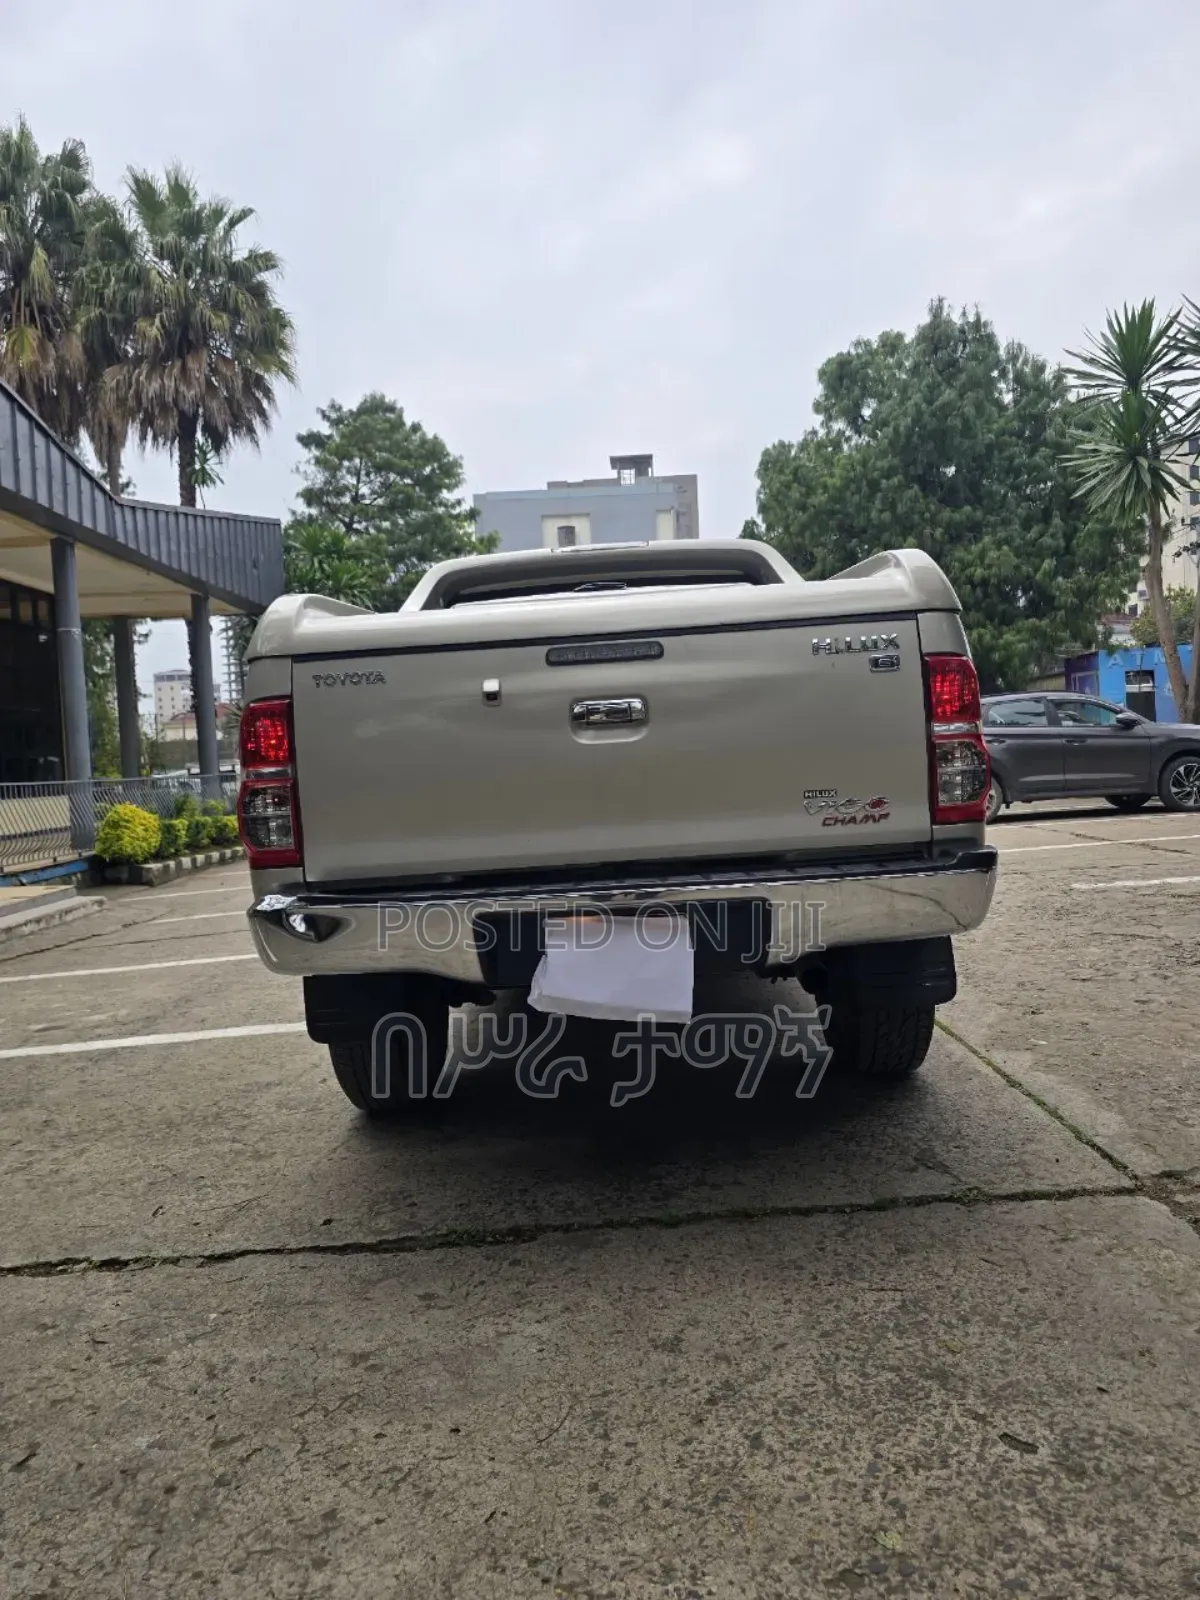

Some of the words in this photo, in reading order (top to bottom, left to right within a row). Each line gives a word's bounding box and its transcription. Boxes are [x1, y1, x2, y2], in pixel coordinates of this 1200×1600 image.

[312, 670, 386, 688] TOYOTA
[804, 789, 837, 799] HILUX
[821, 812, 891, 827] CHAMP
